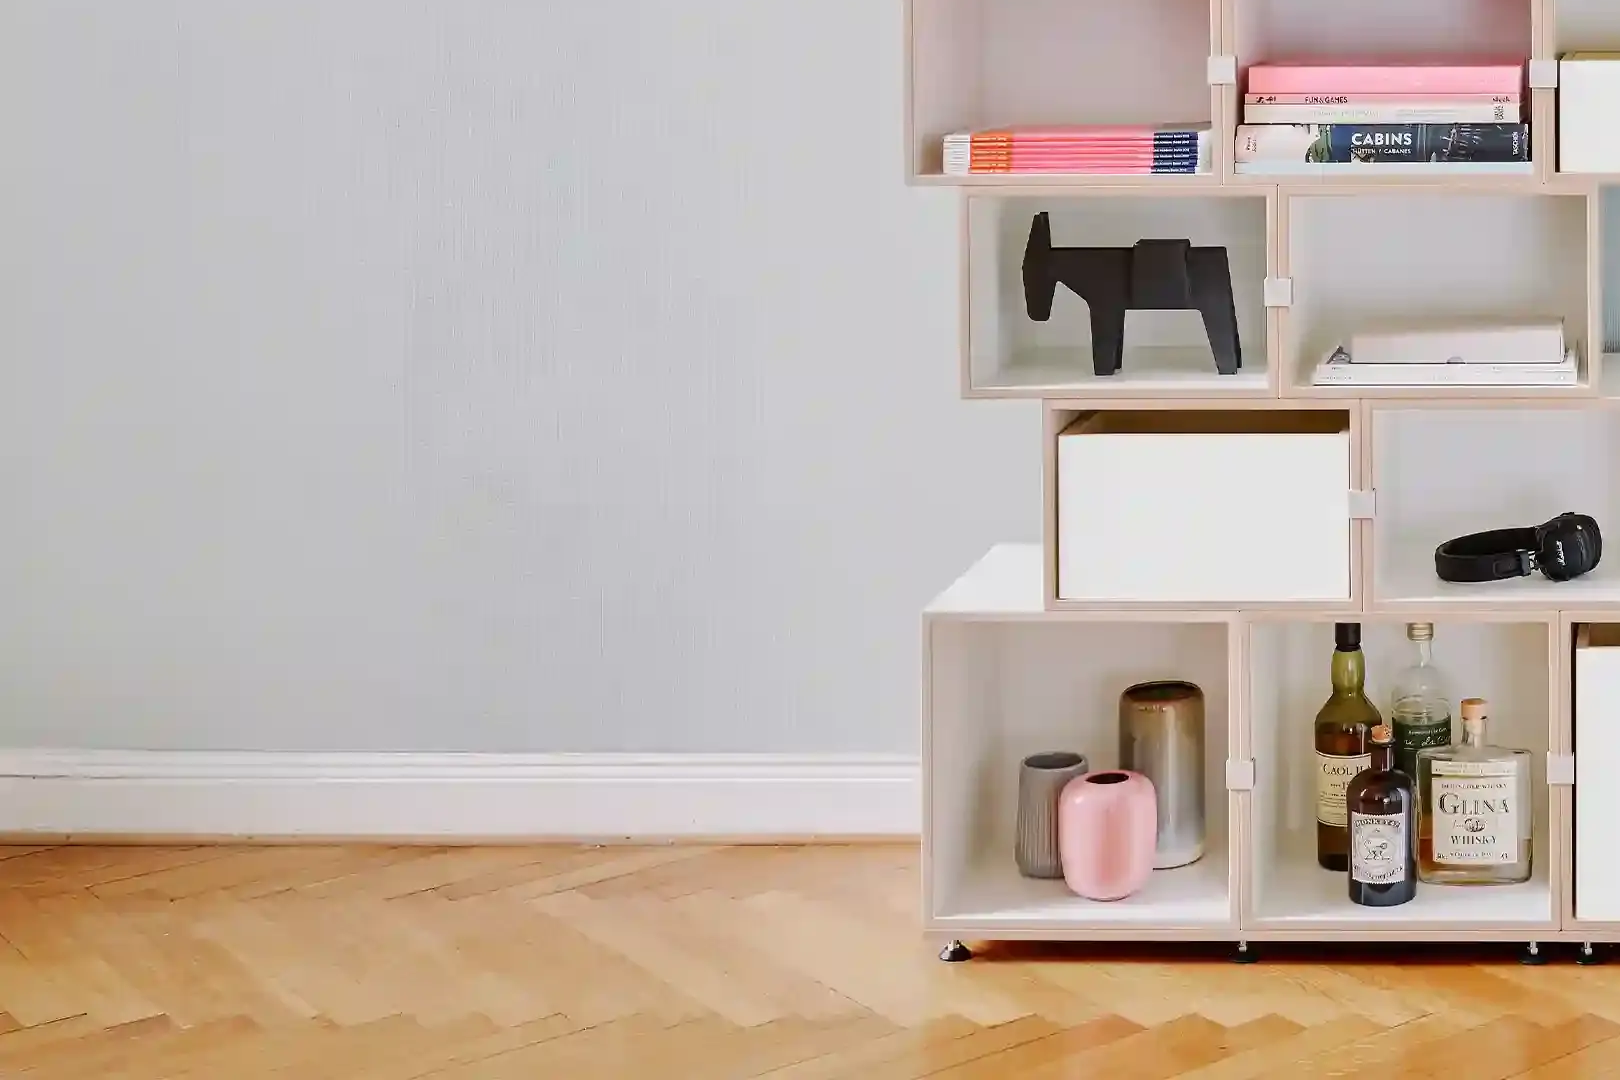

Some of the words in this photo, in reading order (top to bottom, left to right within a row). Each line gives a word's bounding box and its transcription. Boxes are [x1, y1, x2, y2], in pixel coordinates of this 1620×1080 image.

[1351, 132, 1412, 146] CABINS
[1323, 763, 1352, 776] CAOL
[1439, 791, 1510, 815] GLINA
[1450, 835, 1497, 845] WHISKY
